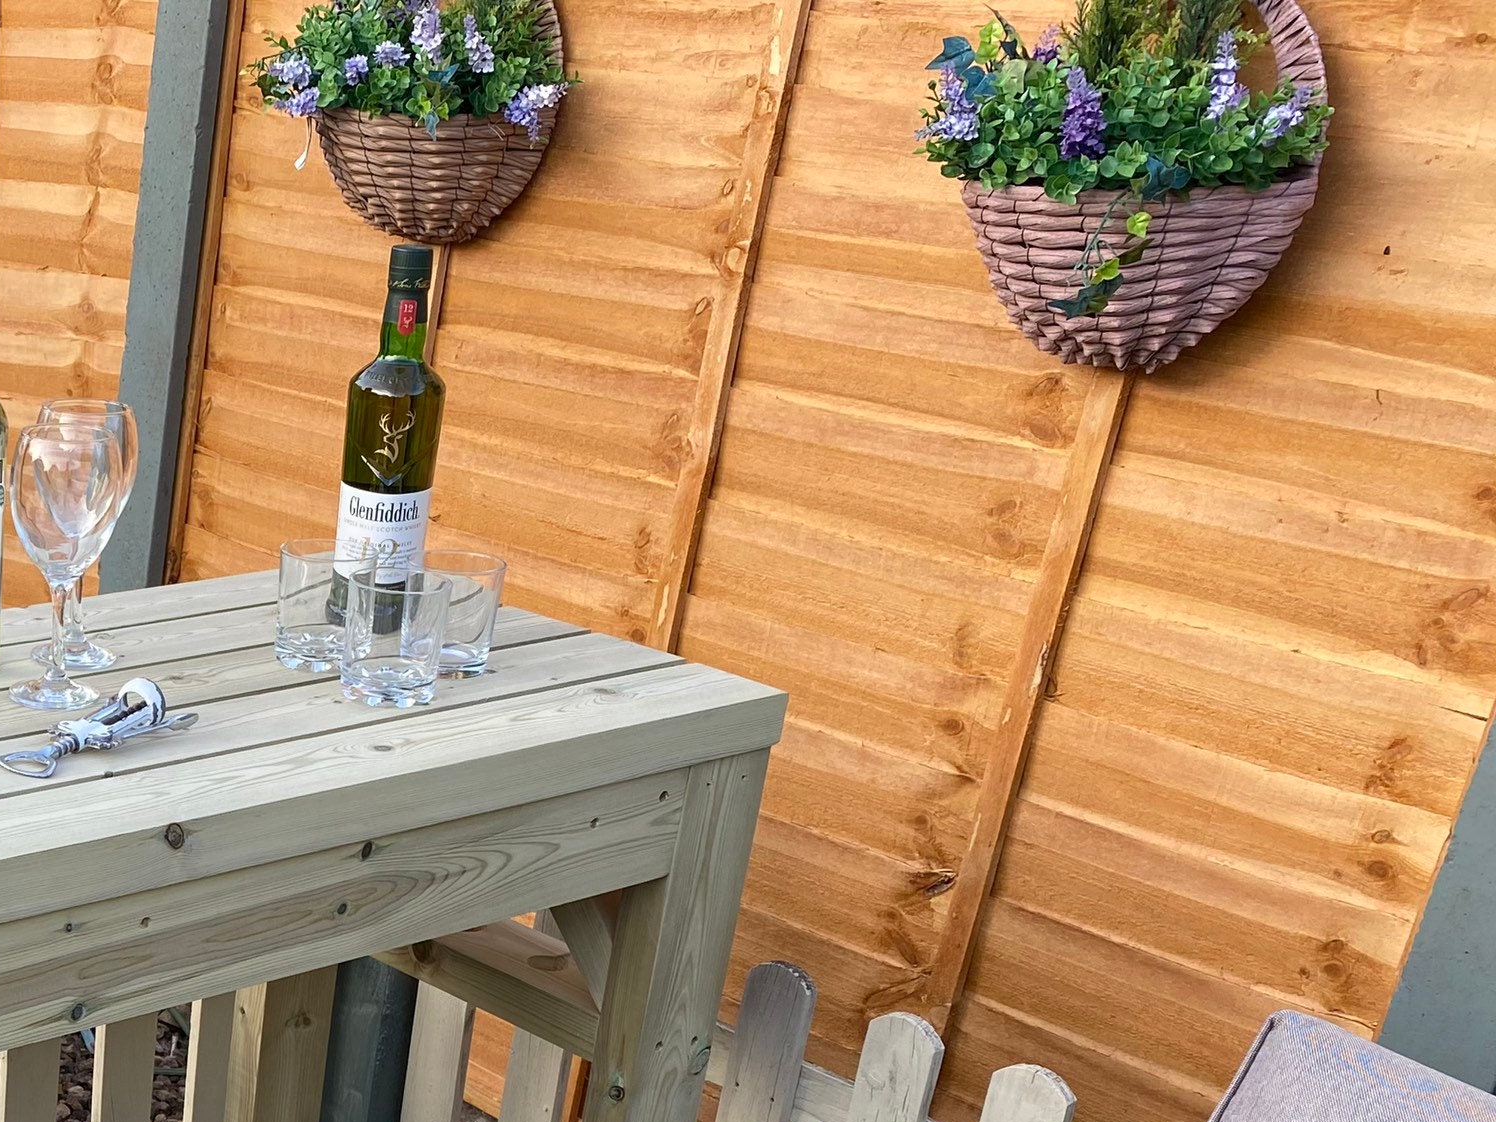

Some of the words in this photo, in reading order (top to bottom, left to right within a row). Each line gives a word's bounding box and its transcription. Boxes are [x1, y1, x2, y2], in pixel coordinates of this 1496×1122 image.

[404, 304, 414, 313] 12
[349, 495, 419, 523] Glenfiddich
[376, 525, 403, 533] SCOTCH
